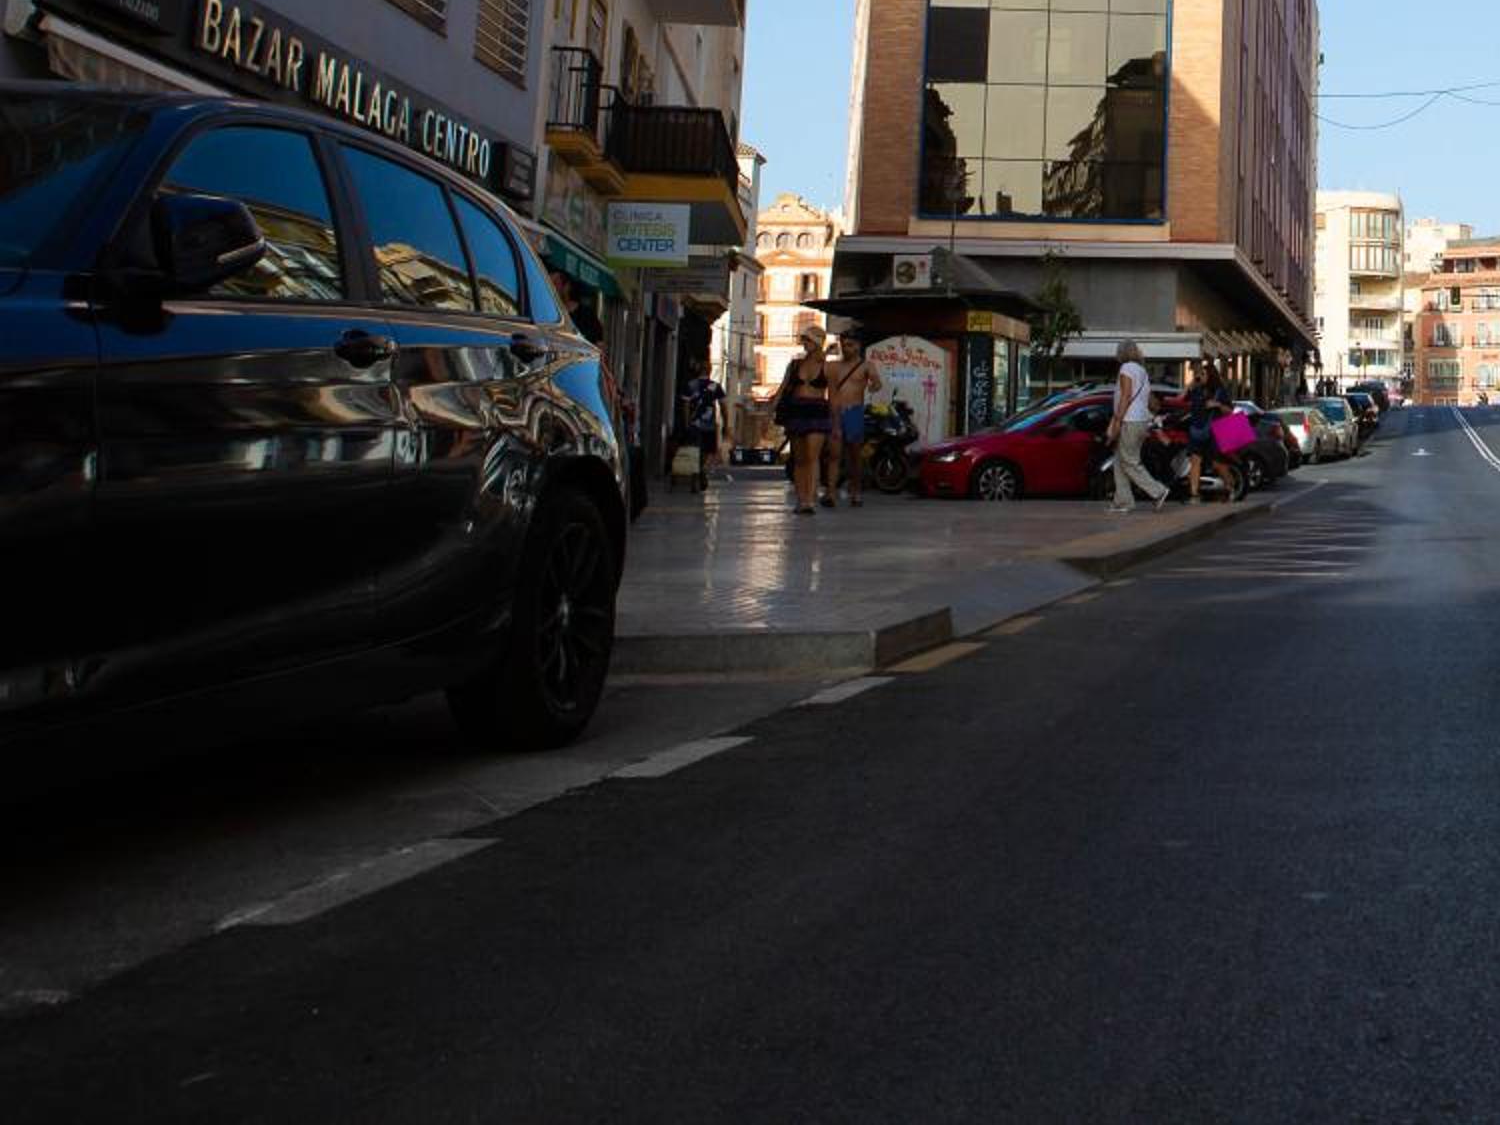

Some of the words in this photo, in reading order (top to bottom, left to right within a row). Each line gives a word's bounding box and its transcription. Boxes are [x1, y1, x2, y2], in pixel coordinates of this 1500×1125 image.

[314, 50, 410, 143] MALAGA
[422, 109, 490, 179] CENTRO
[617, 238, 675, 252] CENTER
